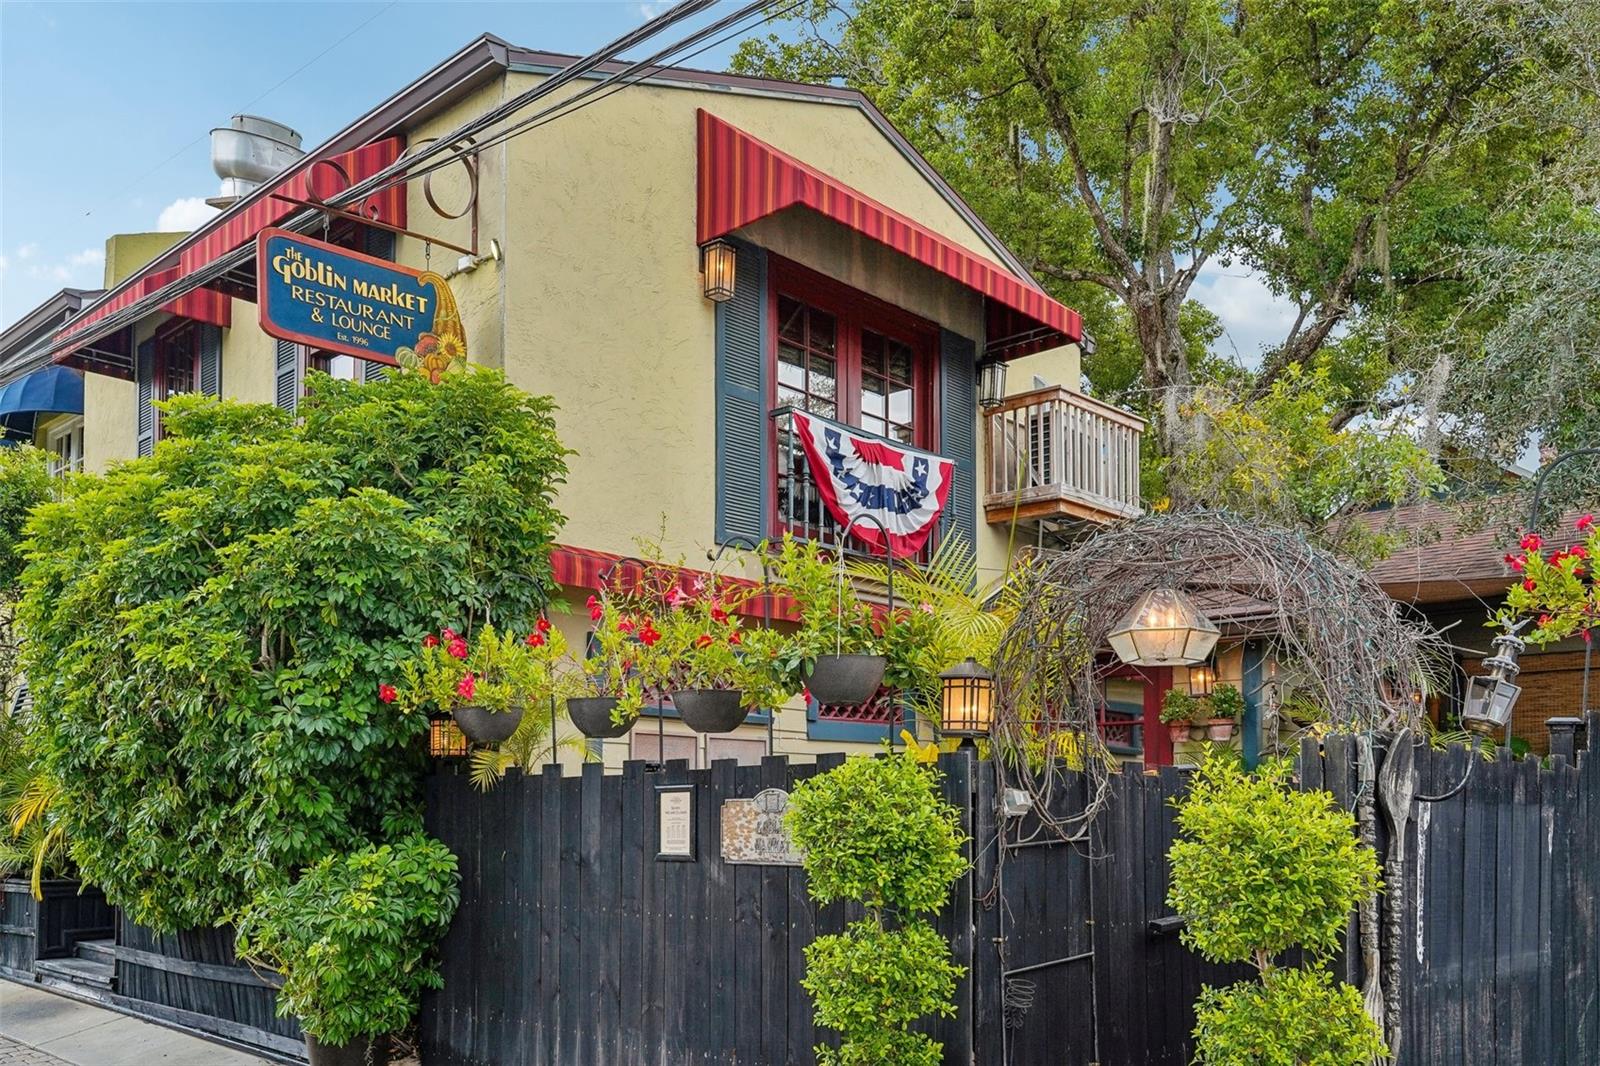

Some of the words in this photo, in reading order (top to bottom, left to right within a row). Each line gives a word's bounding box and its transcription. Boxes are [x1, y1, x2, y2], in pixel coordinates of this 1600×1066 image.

[291, 285, 414, 330] RESTAURANT
[311, 308, 324, 323] &
[331, 313, 391, 340] LOUNGE
[352, 335, 369, 347] 1996
